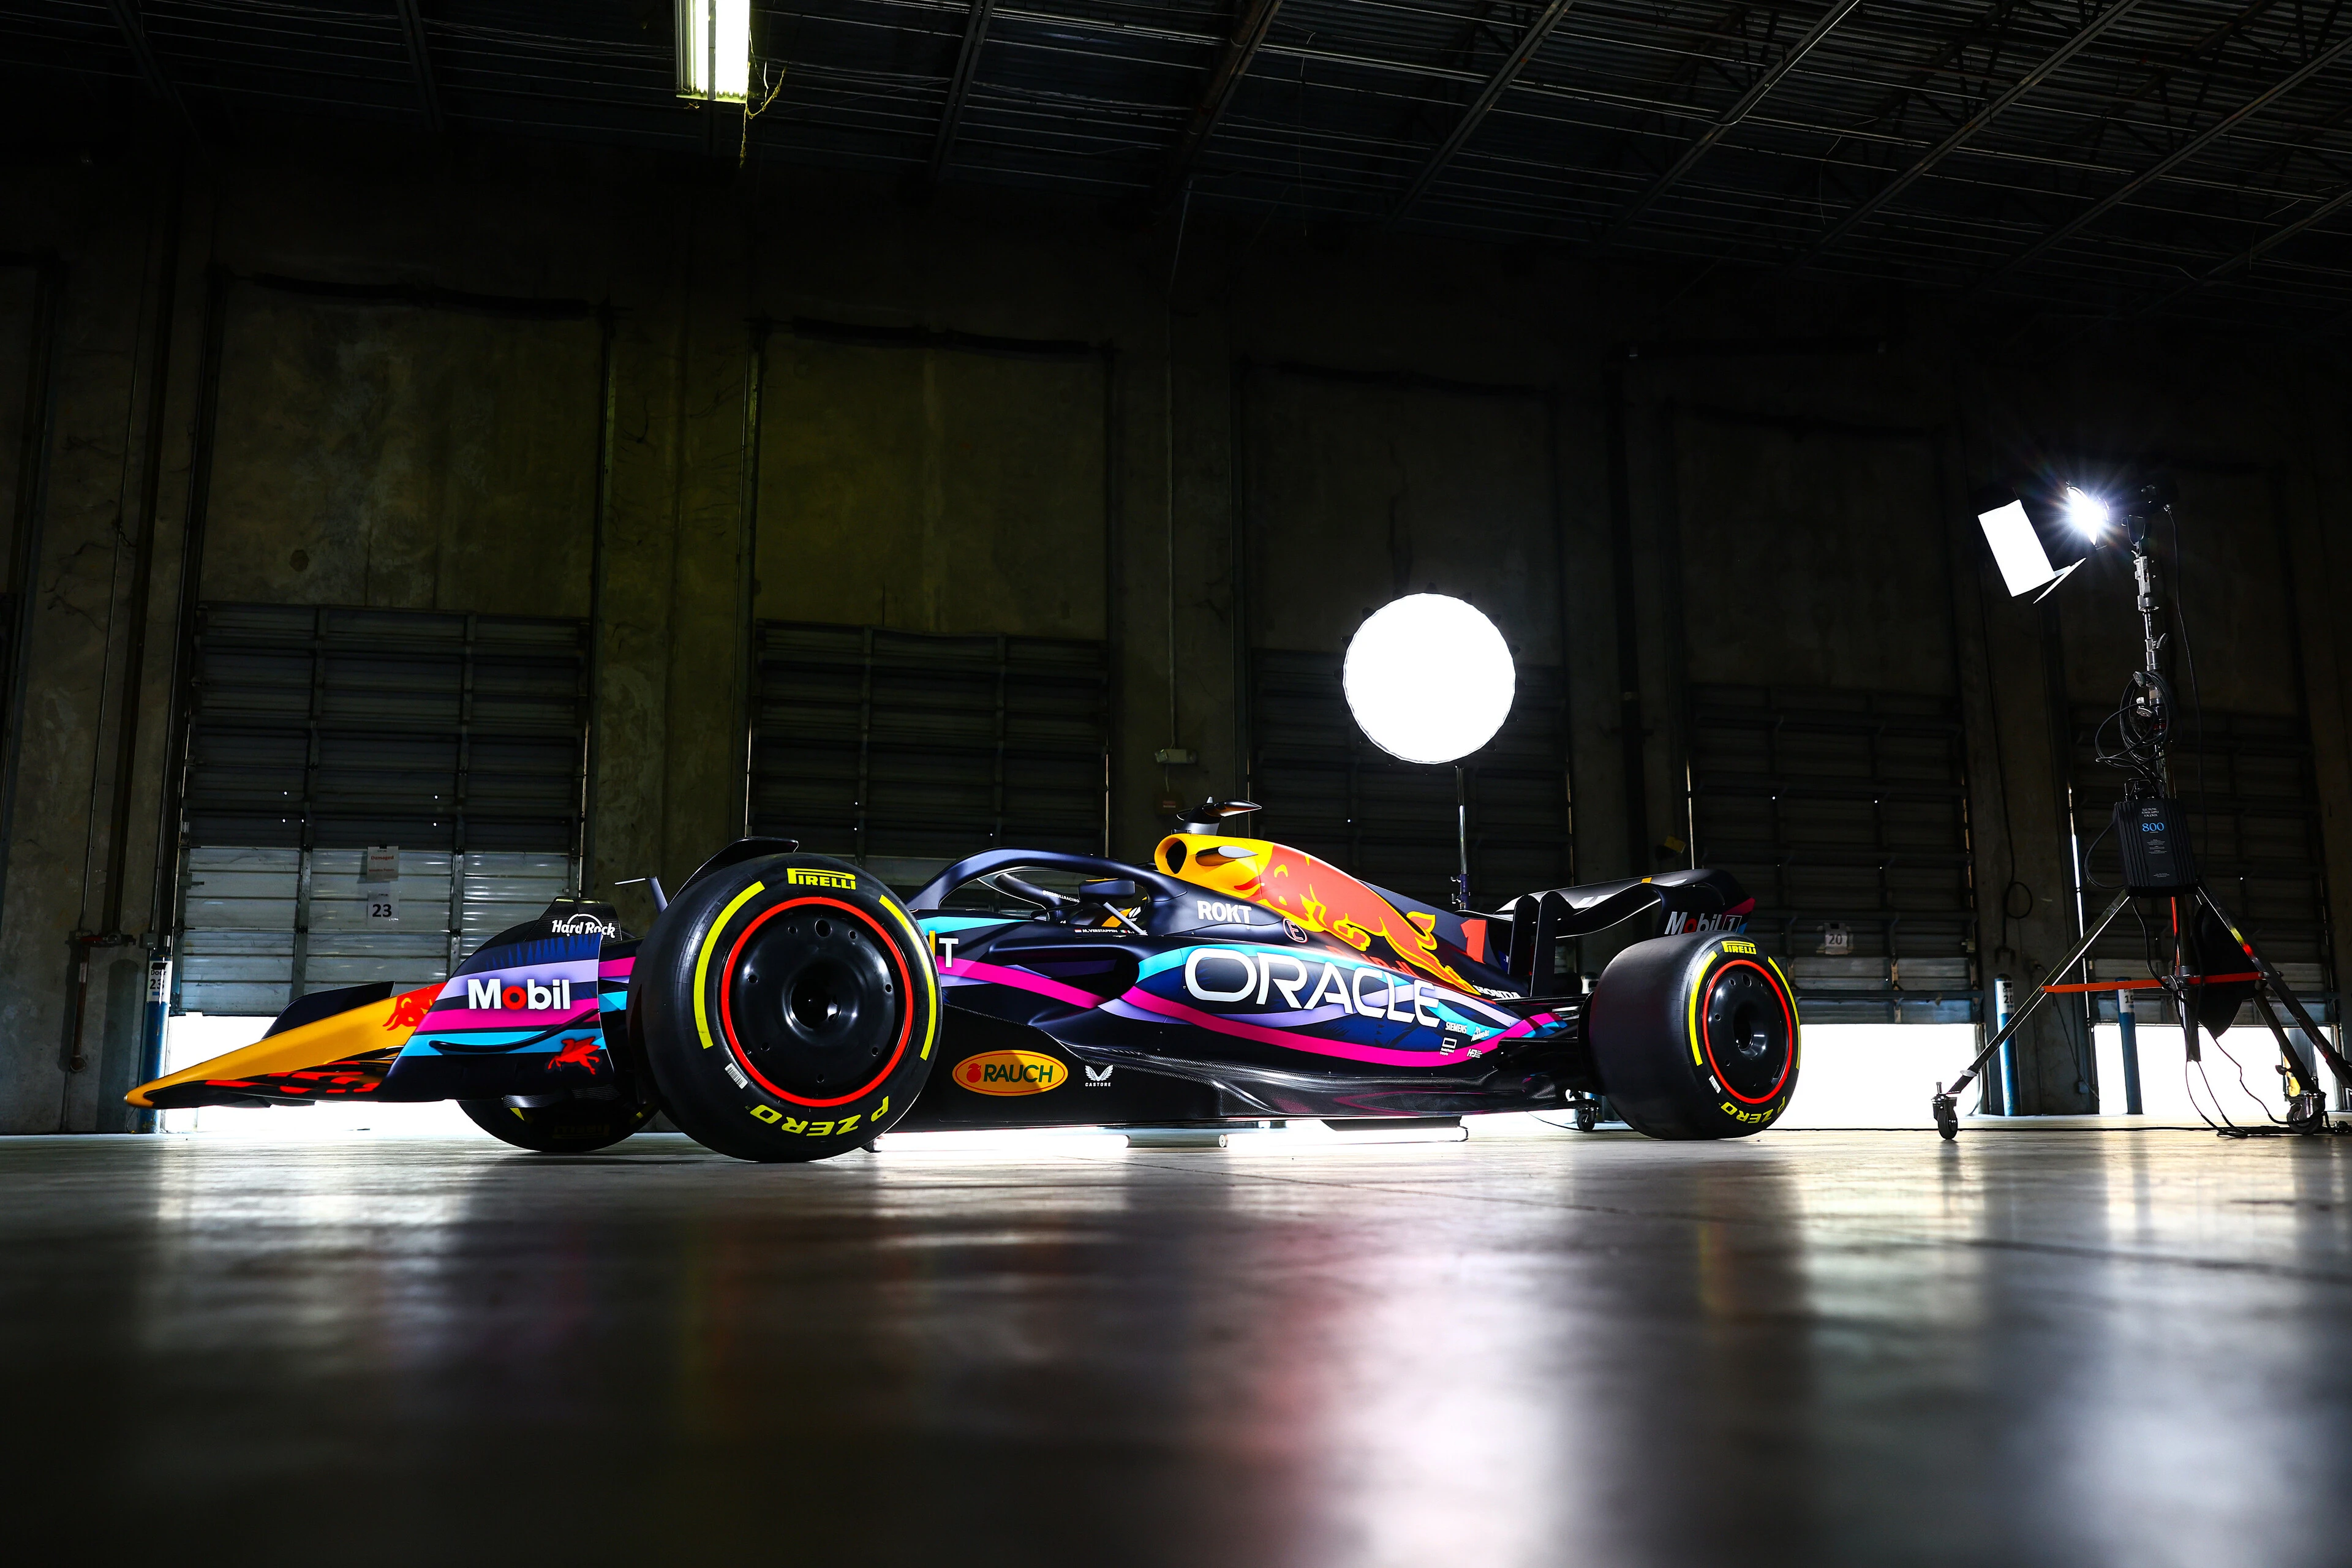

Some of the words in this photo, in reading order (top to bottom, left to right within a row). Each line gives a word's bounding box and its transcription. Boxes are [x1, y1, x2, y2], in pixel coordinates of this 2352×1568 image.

[2142, 822, 2164, 832] 800
[787, 868, 856, 891] PIRELLI
[372, 903, 392, 917] 23
[1197, 900, 1252, 924] ROKT
[551, 919, 584, 935] Hard
[585, 922, 616, 938] Rock
[1664, 911, 1722, 935] Mobil
[1460, 919, 1487, 964] 1
[1721, 940, 1757, 955] PIRELLI
[1828, 933, 1843, 945] 20
[149, 979, 165, 989] 23
[1185, 948, 1441, 1028] ORACLE
[1472, 984, 1521, 999] HONDA
[467, 978, 571, 1010] Mobil
[1446, 1021, 1468, 1034] SIEMENS
[984, 1064, 1054, 1083] RAUCH
[870, 1095, 889, 1122] P
[1721, 1101, 1774, 1123] ZERO
[1777, 1096, 1786, 1114] P
[750, 1104, 861, 1136] ZERO
